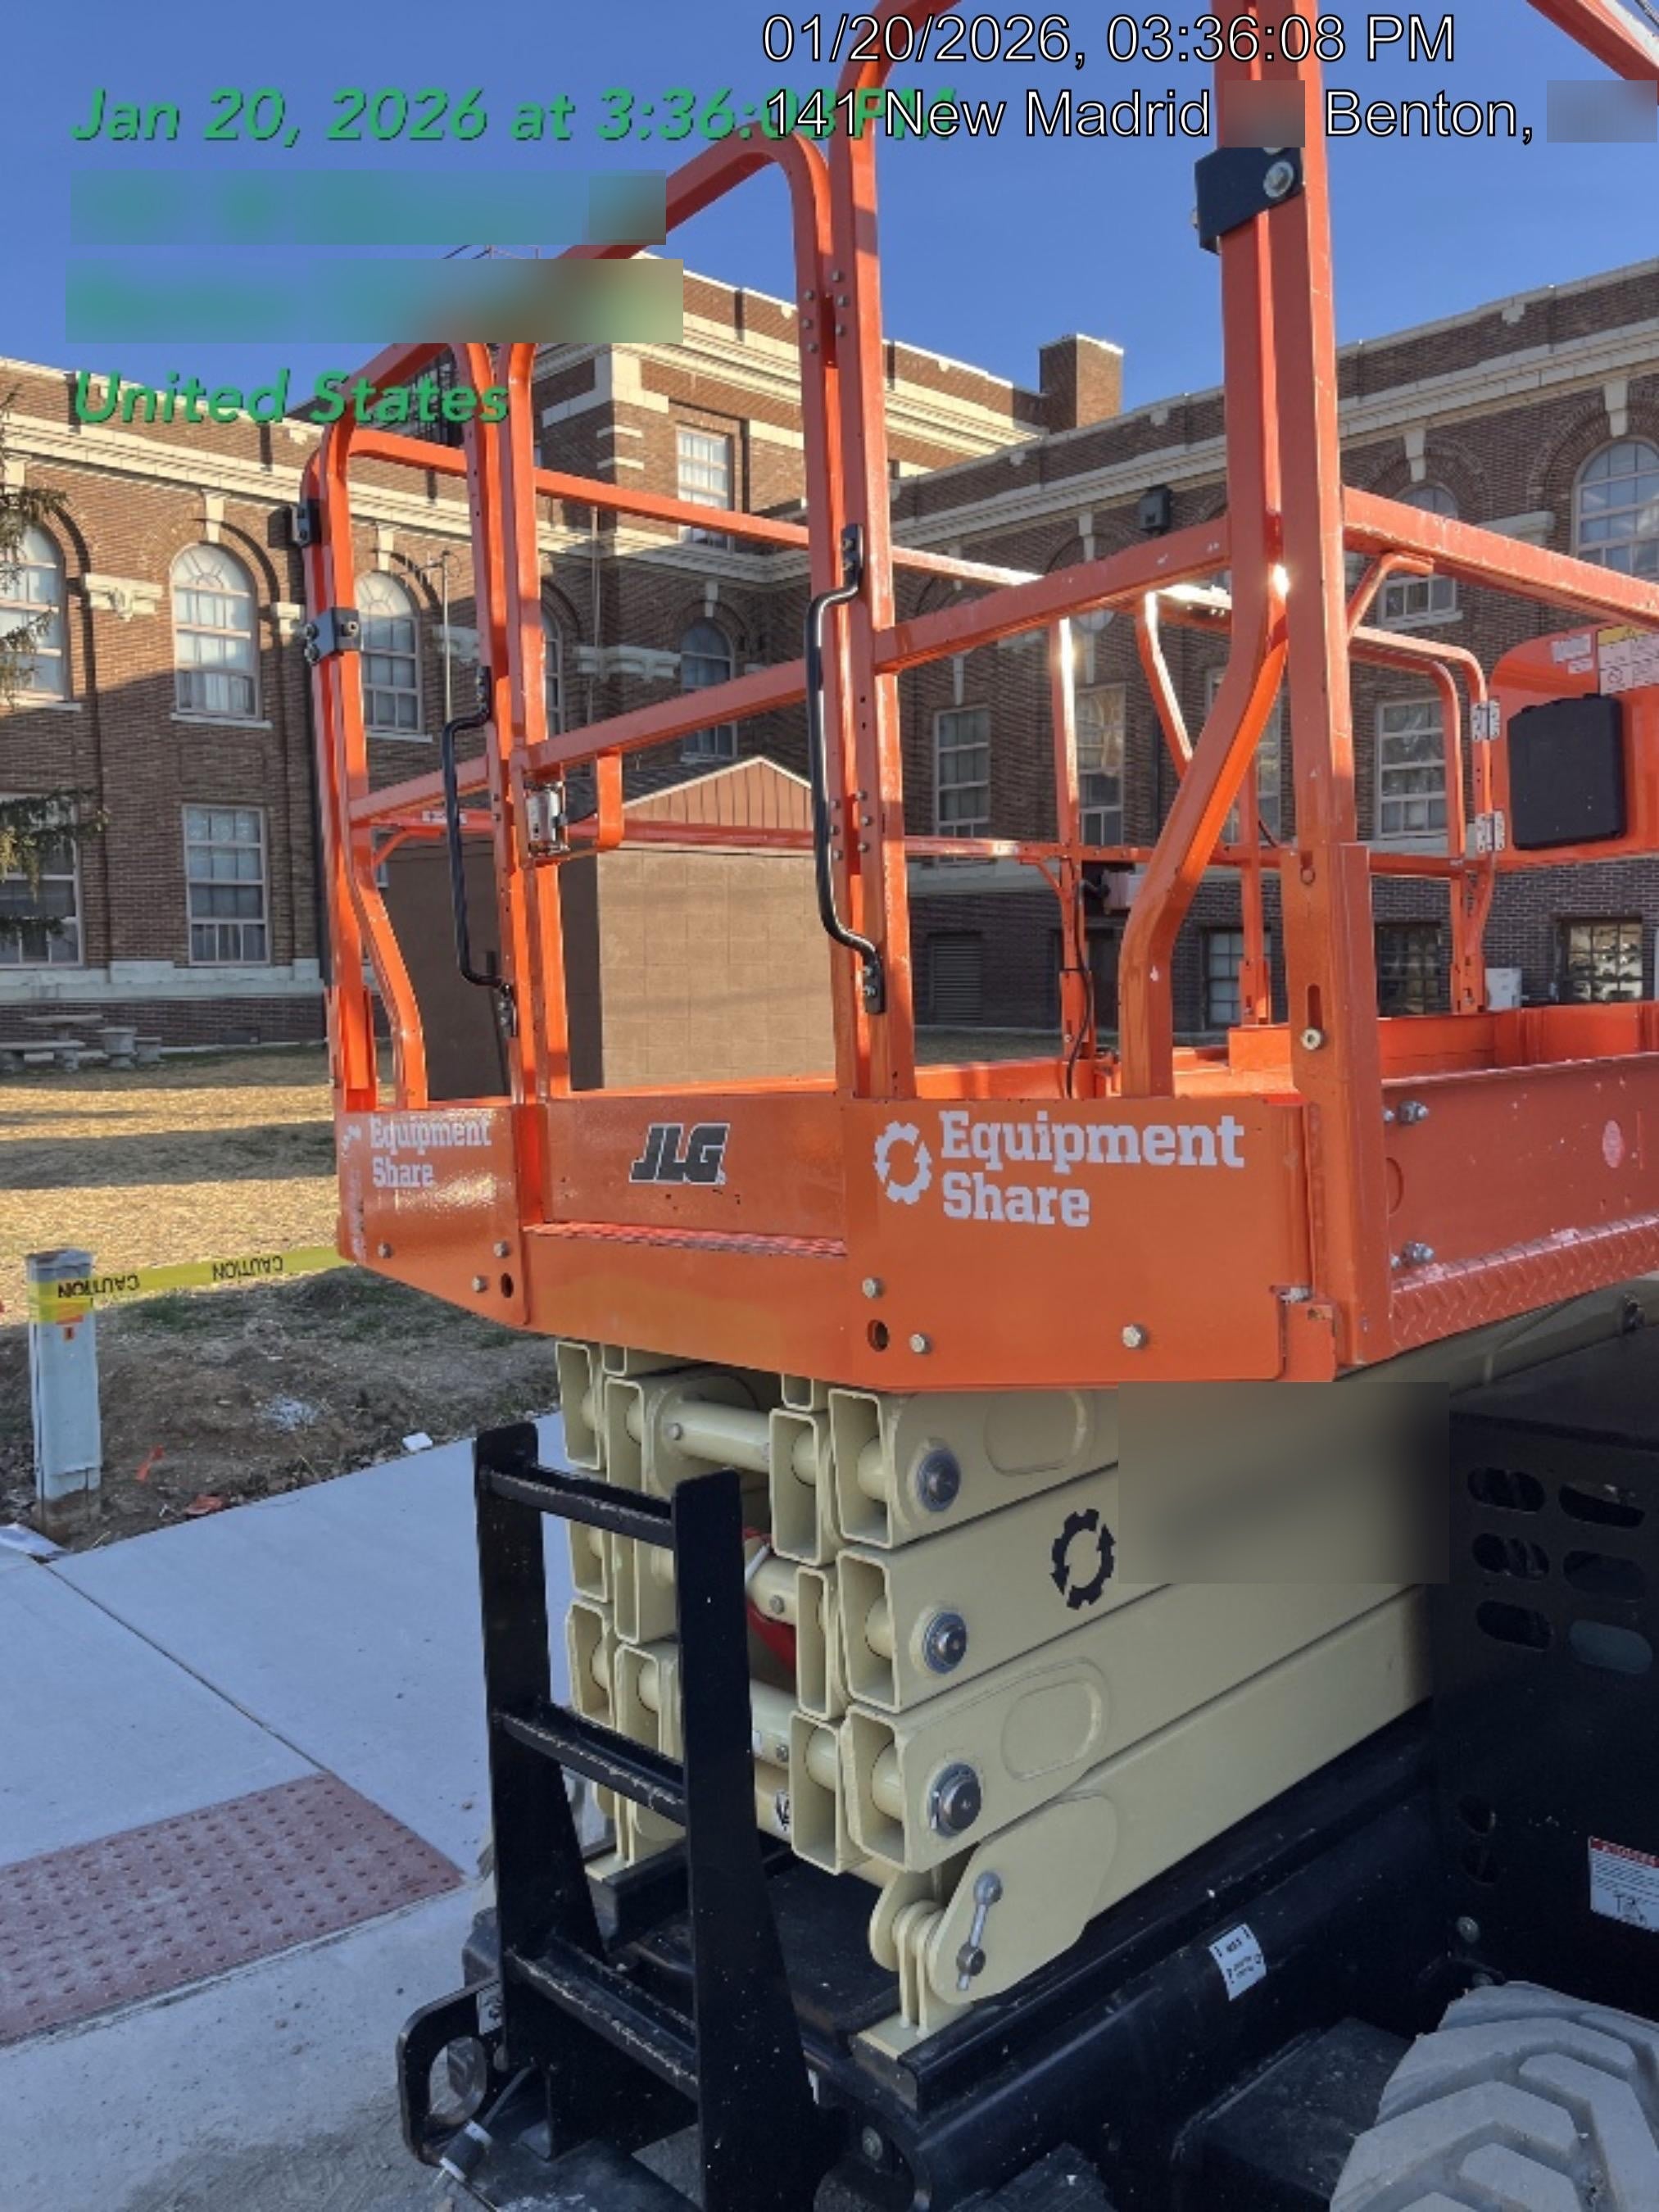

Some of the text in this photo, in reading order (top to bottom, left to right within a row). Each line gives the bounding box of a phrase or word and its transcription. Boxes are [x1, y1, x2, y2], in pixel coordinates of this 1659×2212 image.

[370, 1113, 492, 1156] Equipment
[629, 1122, 730, 1185] JLG
[939, 1110, 1244, 1175] Equipment
[373, 1156, 433, 1187] Share
[941, 1172, 1090, 1227] Share
[57, 1274, 140, 1299] CAUTION
[211, 1255, 284, 1280] CAUTION
